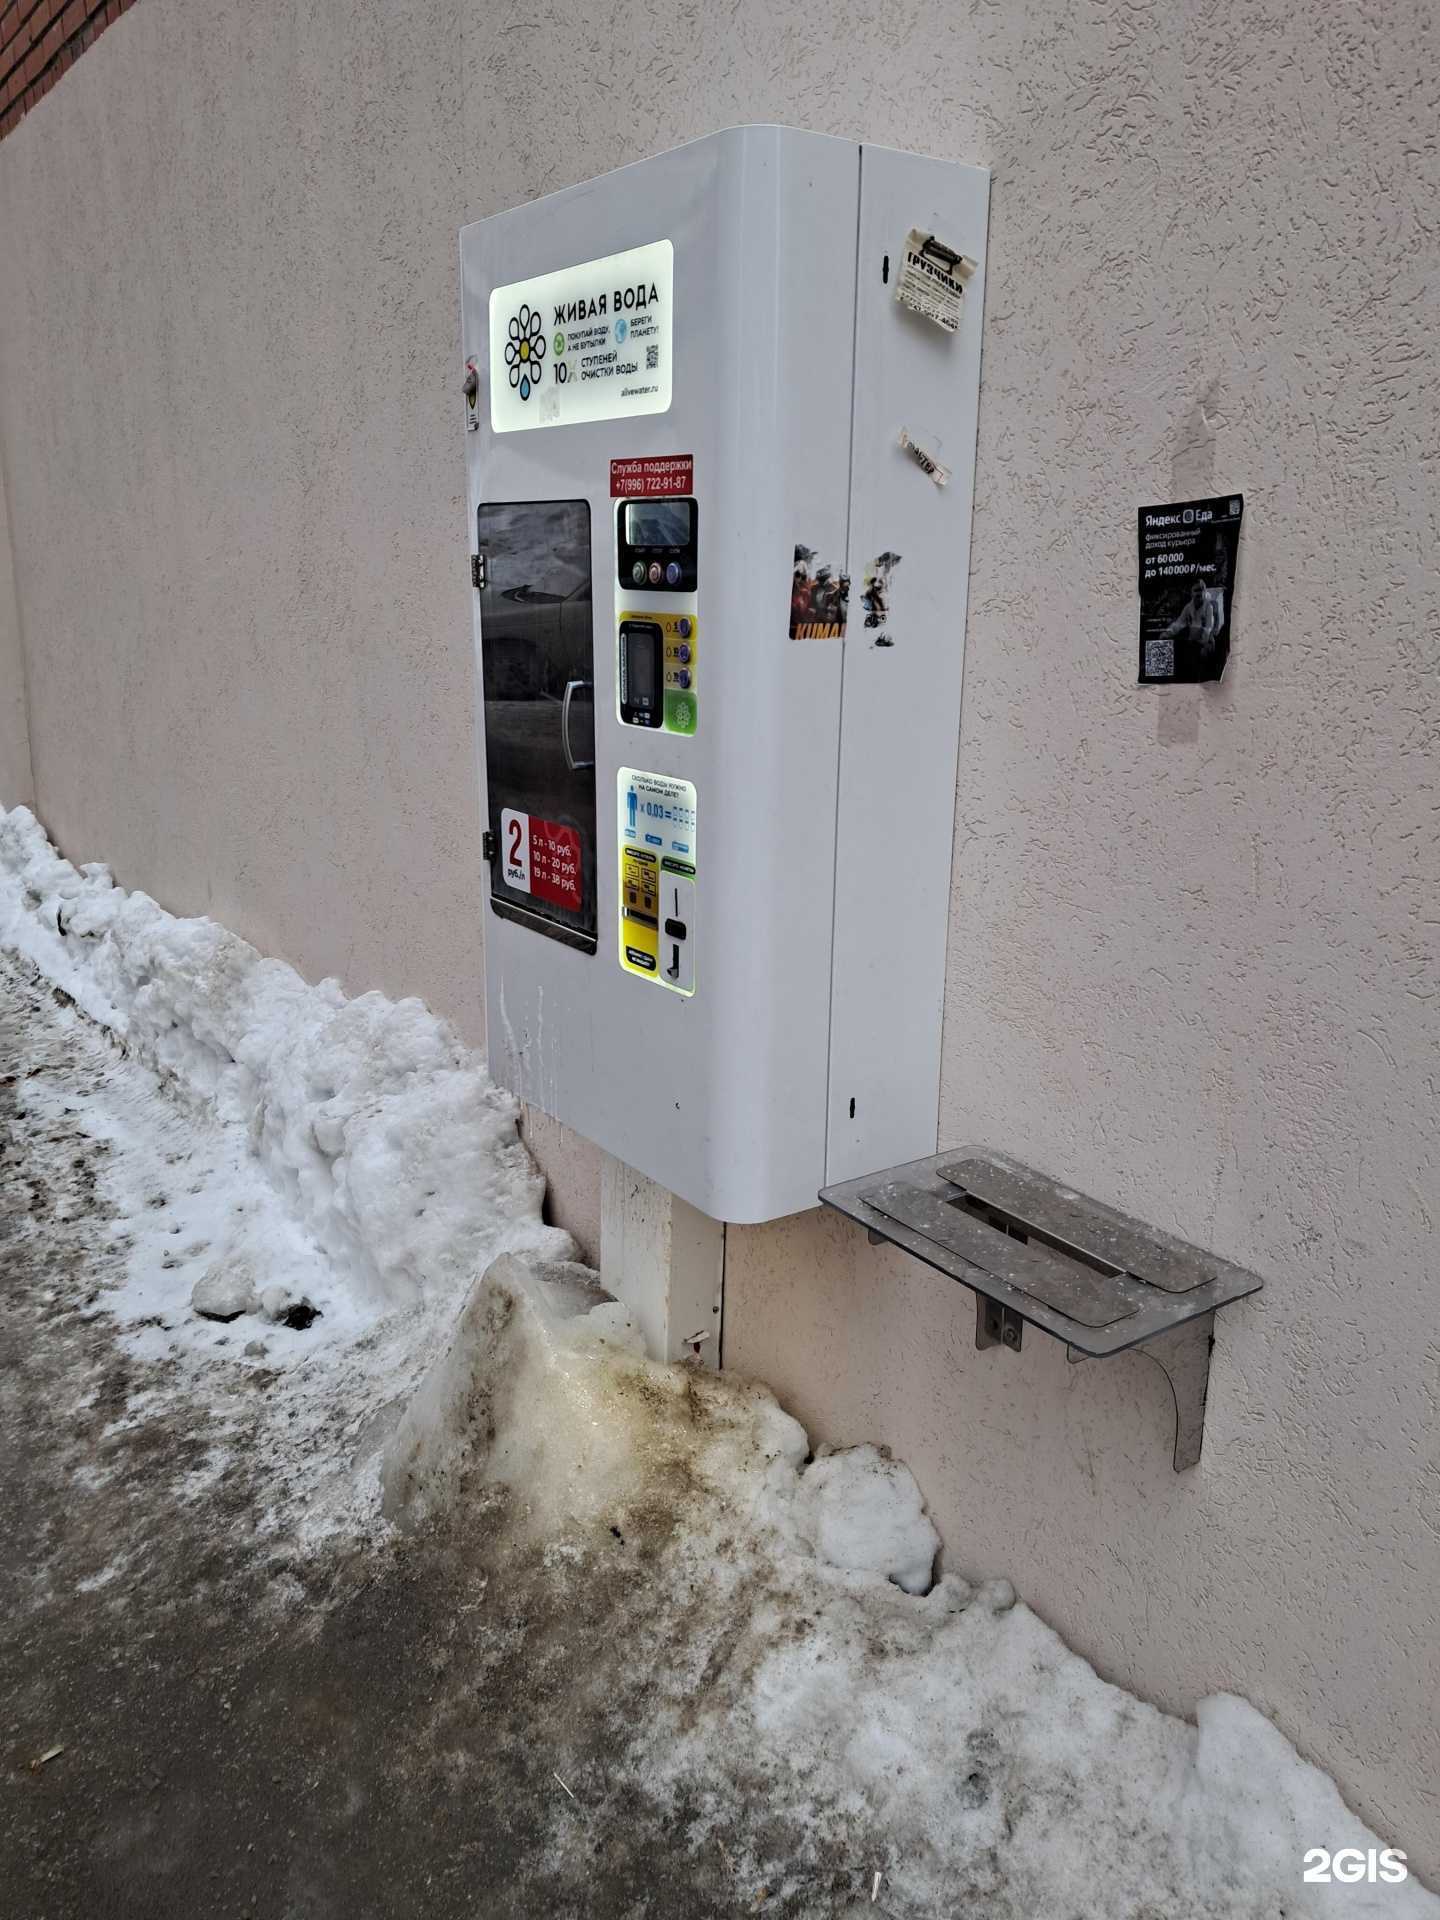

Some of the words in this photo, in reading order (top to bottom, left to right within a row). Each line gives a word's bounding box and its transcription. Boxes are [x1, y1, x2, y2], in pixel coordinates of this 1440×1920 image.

[553, 294, 607, 326] ЖИВАЯ
[613, 283, 659, 312] ВОДА
[630, 315, 652, 327] БЕРЕГИ
[567, 327, 593, 341] ПОКУПАЙ
[572, 343, 580, 351] НЕ
[580, 337, 606, 350] БУТЫЛКИ
[580, 350, 618, 368] СТУПЕНЕЙ
[580, 365, 615, 381] ОЧИСТКИ
[616, 362, 638, 375] ВОДЫ
[620, 385, 659, 397] alivewater.ru
[611, 461, 642, 477] Служба
[643, 460, 692, 474] поддержки
[616, 478, 645, 493] +7(996)
[646, 475, 687, 490] 722-91-87
[1145, 514, 1181, 528] Яндекс
[1195, 509, 1213, 523] Еда
[1145, 557, 1155, 565] от
[1144, 569, 1157, 579] до
[509, 819, 523, 867] 2
[532, 834, 538, 845] 5
[548, 839, 556, 851] 10
[533, 850, 541, 862] 10
[551, 857, 560, 869] 20
[534, 866, 540, 877] 19
[551, 873, 560, 885] 38
